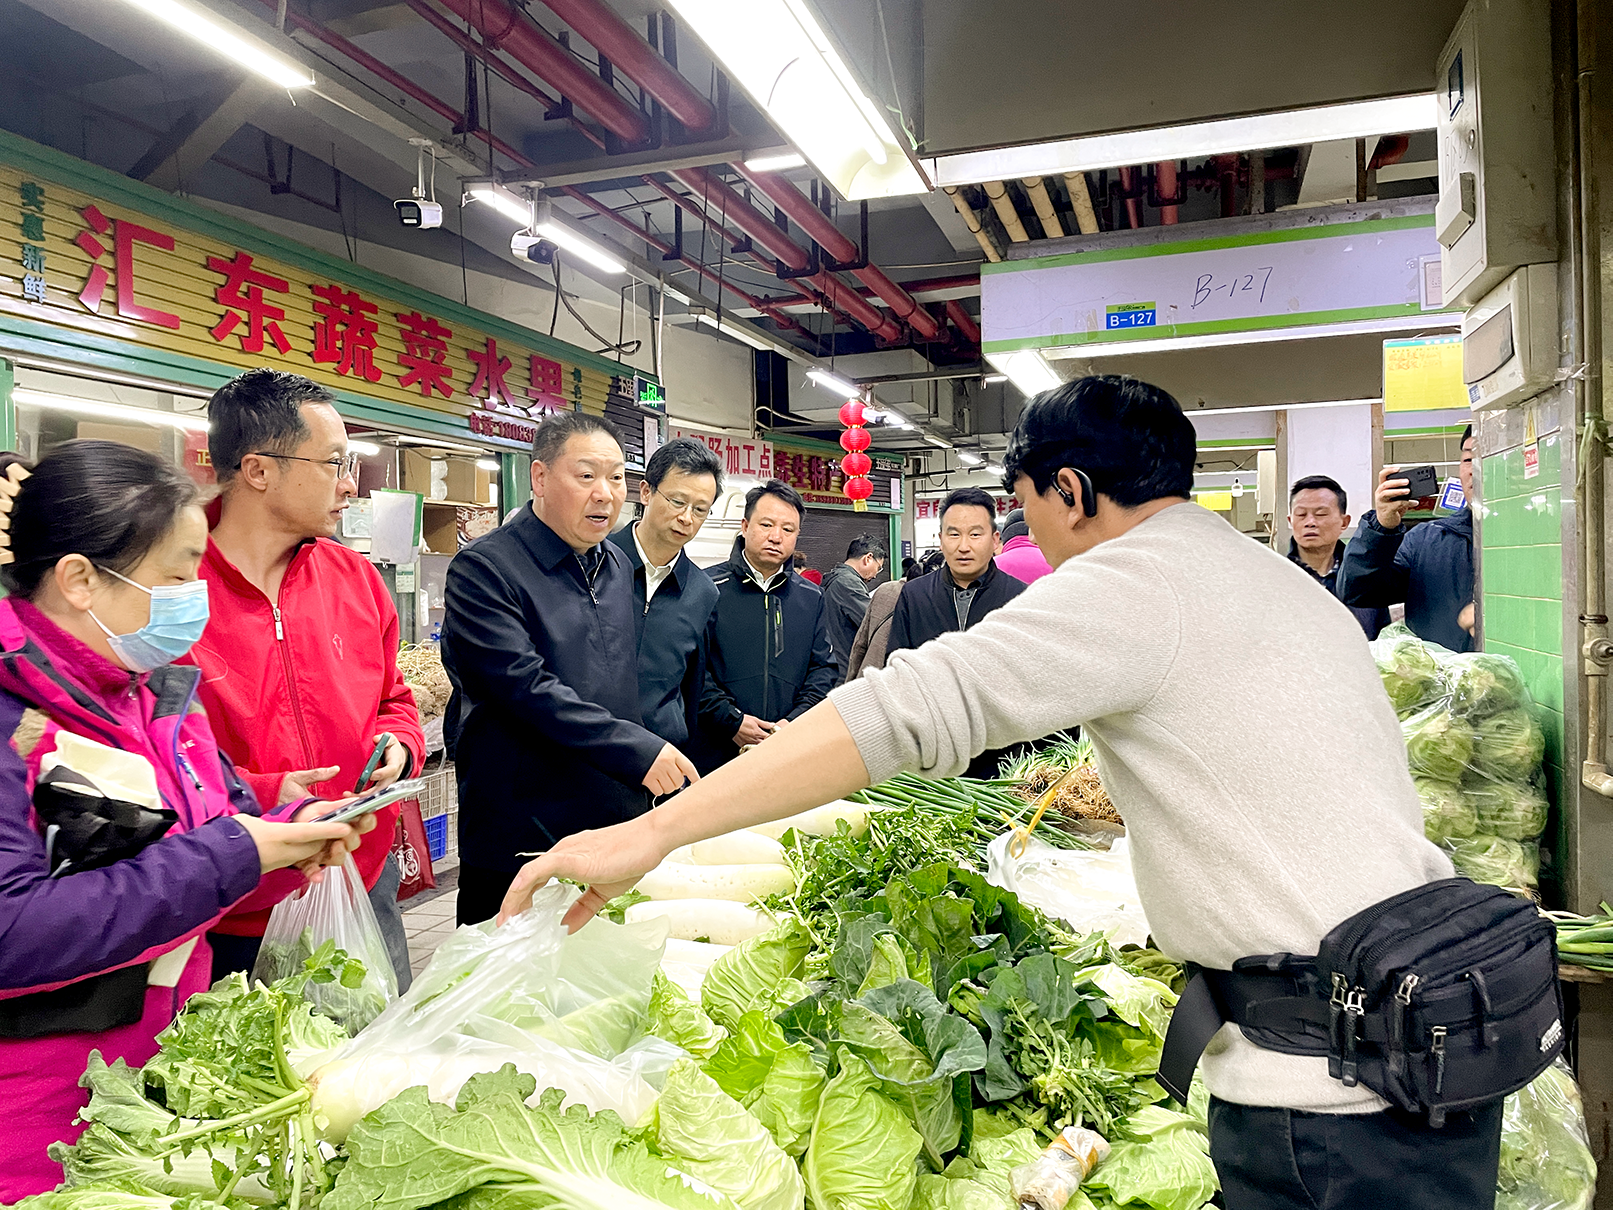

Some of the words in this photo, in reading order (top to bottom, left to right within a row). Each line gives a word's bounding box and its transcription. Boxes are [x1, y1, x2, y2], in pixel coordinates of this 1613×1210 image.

[1190, 267, 1273, 310] B-127
[75, 204, 568, 419] 汇东蔬菜水果
[1110, 312, 1153, 327] B-127
